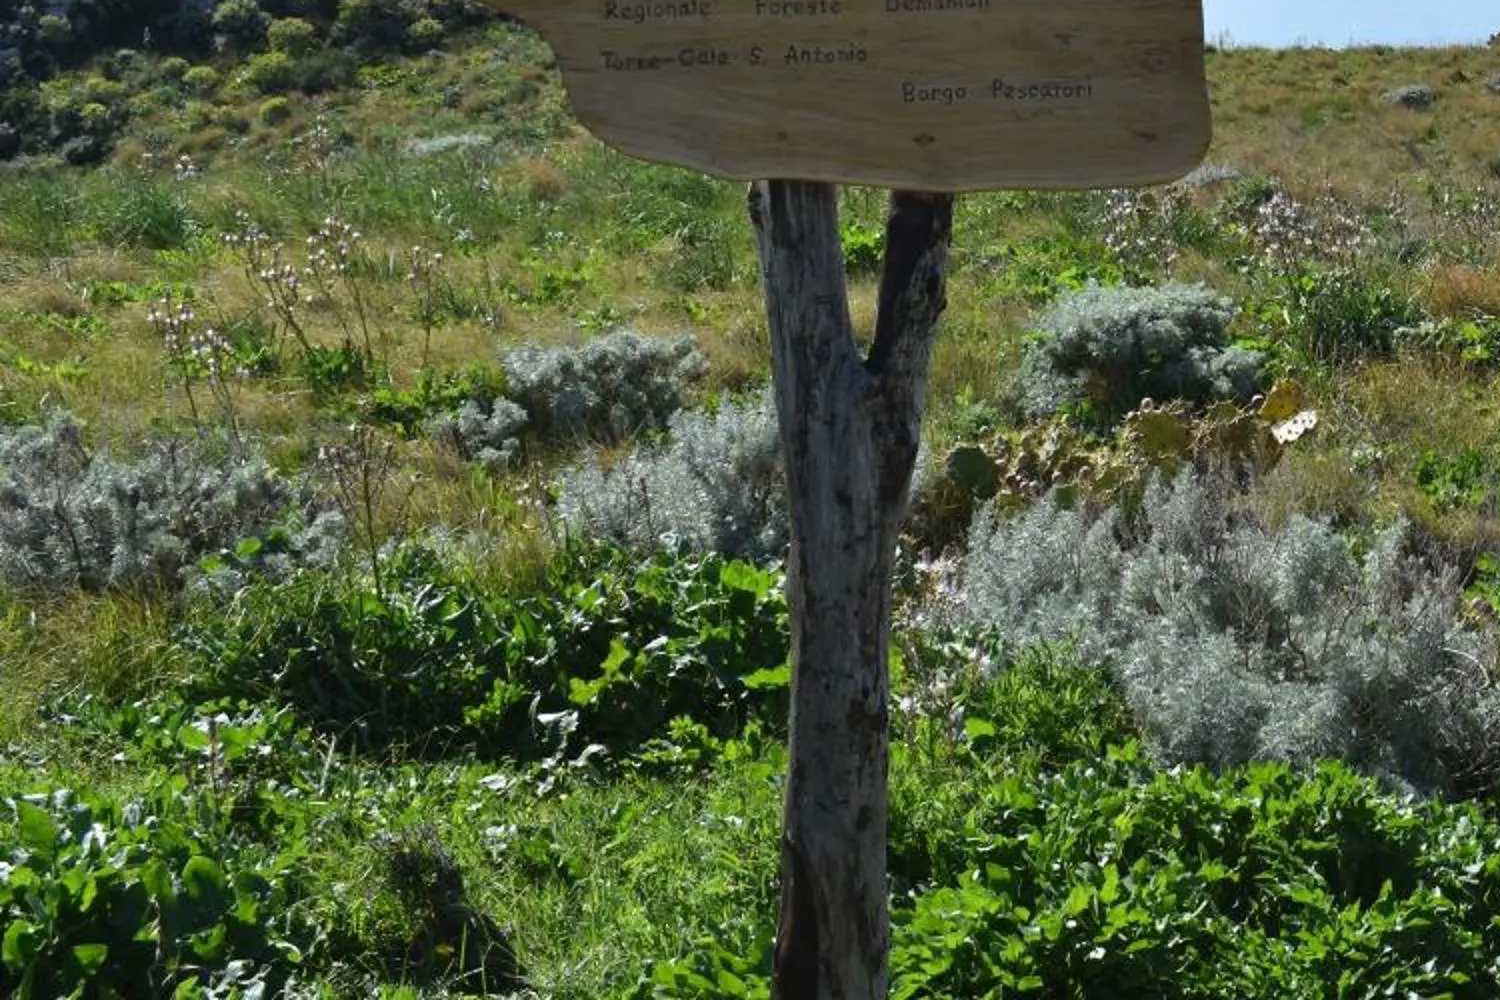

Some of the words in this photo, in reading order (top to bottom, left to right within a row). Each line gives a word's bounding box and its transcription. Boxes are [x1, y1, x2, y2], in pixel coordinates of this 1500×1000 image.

[783, 42, 868, 66] Antonio
[902, 81, 967, 105] Borgo
[991, 75, 1093, 100] Pescatori
